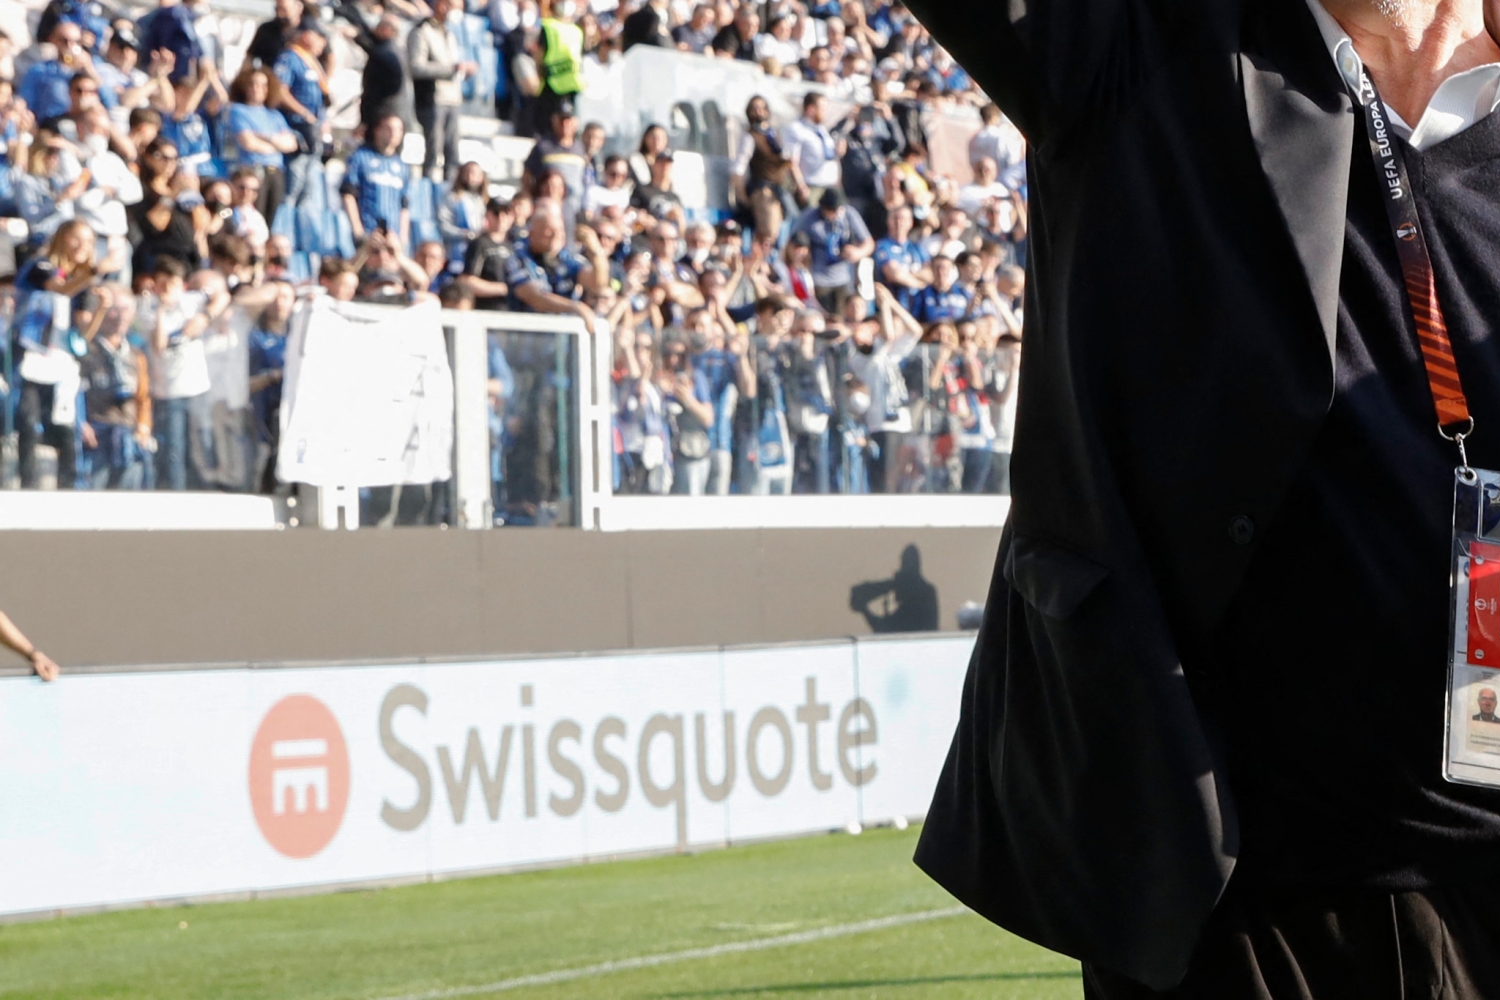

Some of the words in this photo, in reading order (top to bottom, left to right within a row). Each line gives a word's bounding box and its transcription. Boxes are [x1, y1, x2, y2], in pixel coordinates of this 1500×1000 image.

[1361, 73, 1376, 99] LEA
[1370, 101, 1393, 158] EUROPA
[1384, 159, 1403, 200] UEFA
[380, 675, 880, 850] Swissquote
